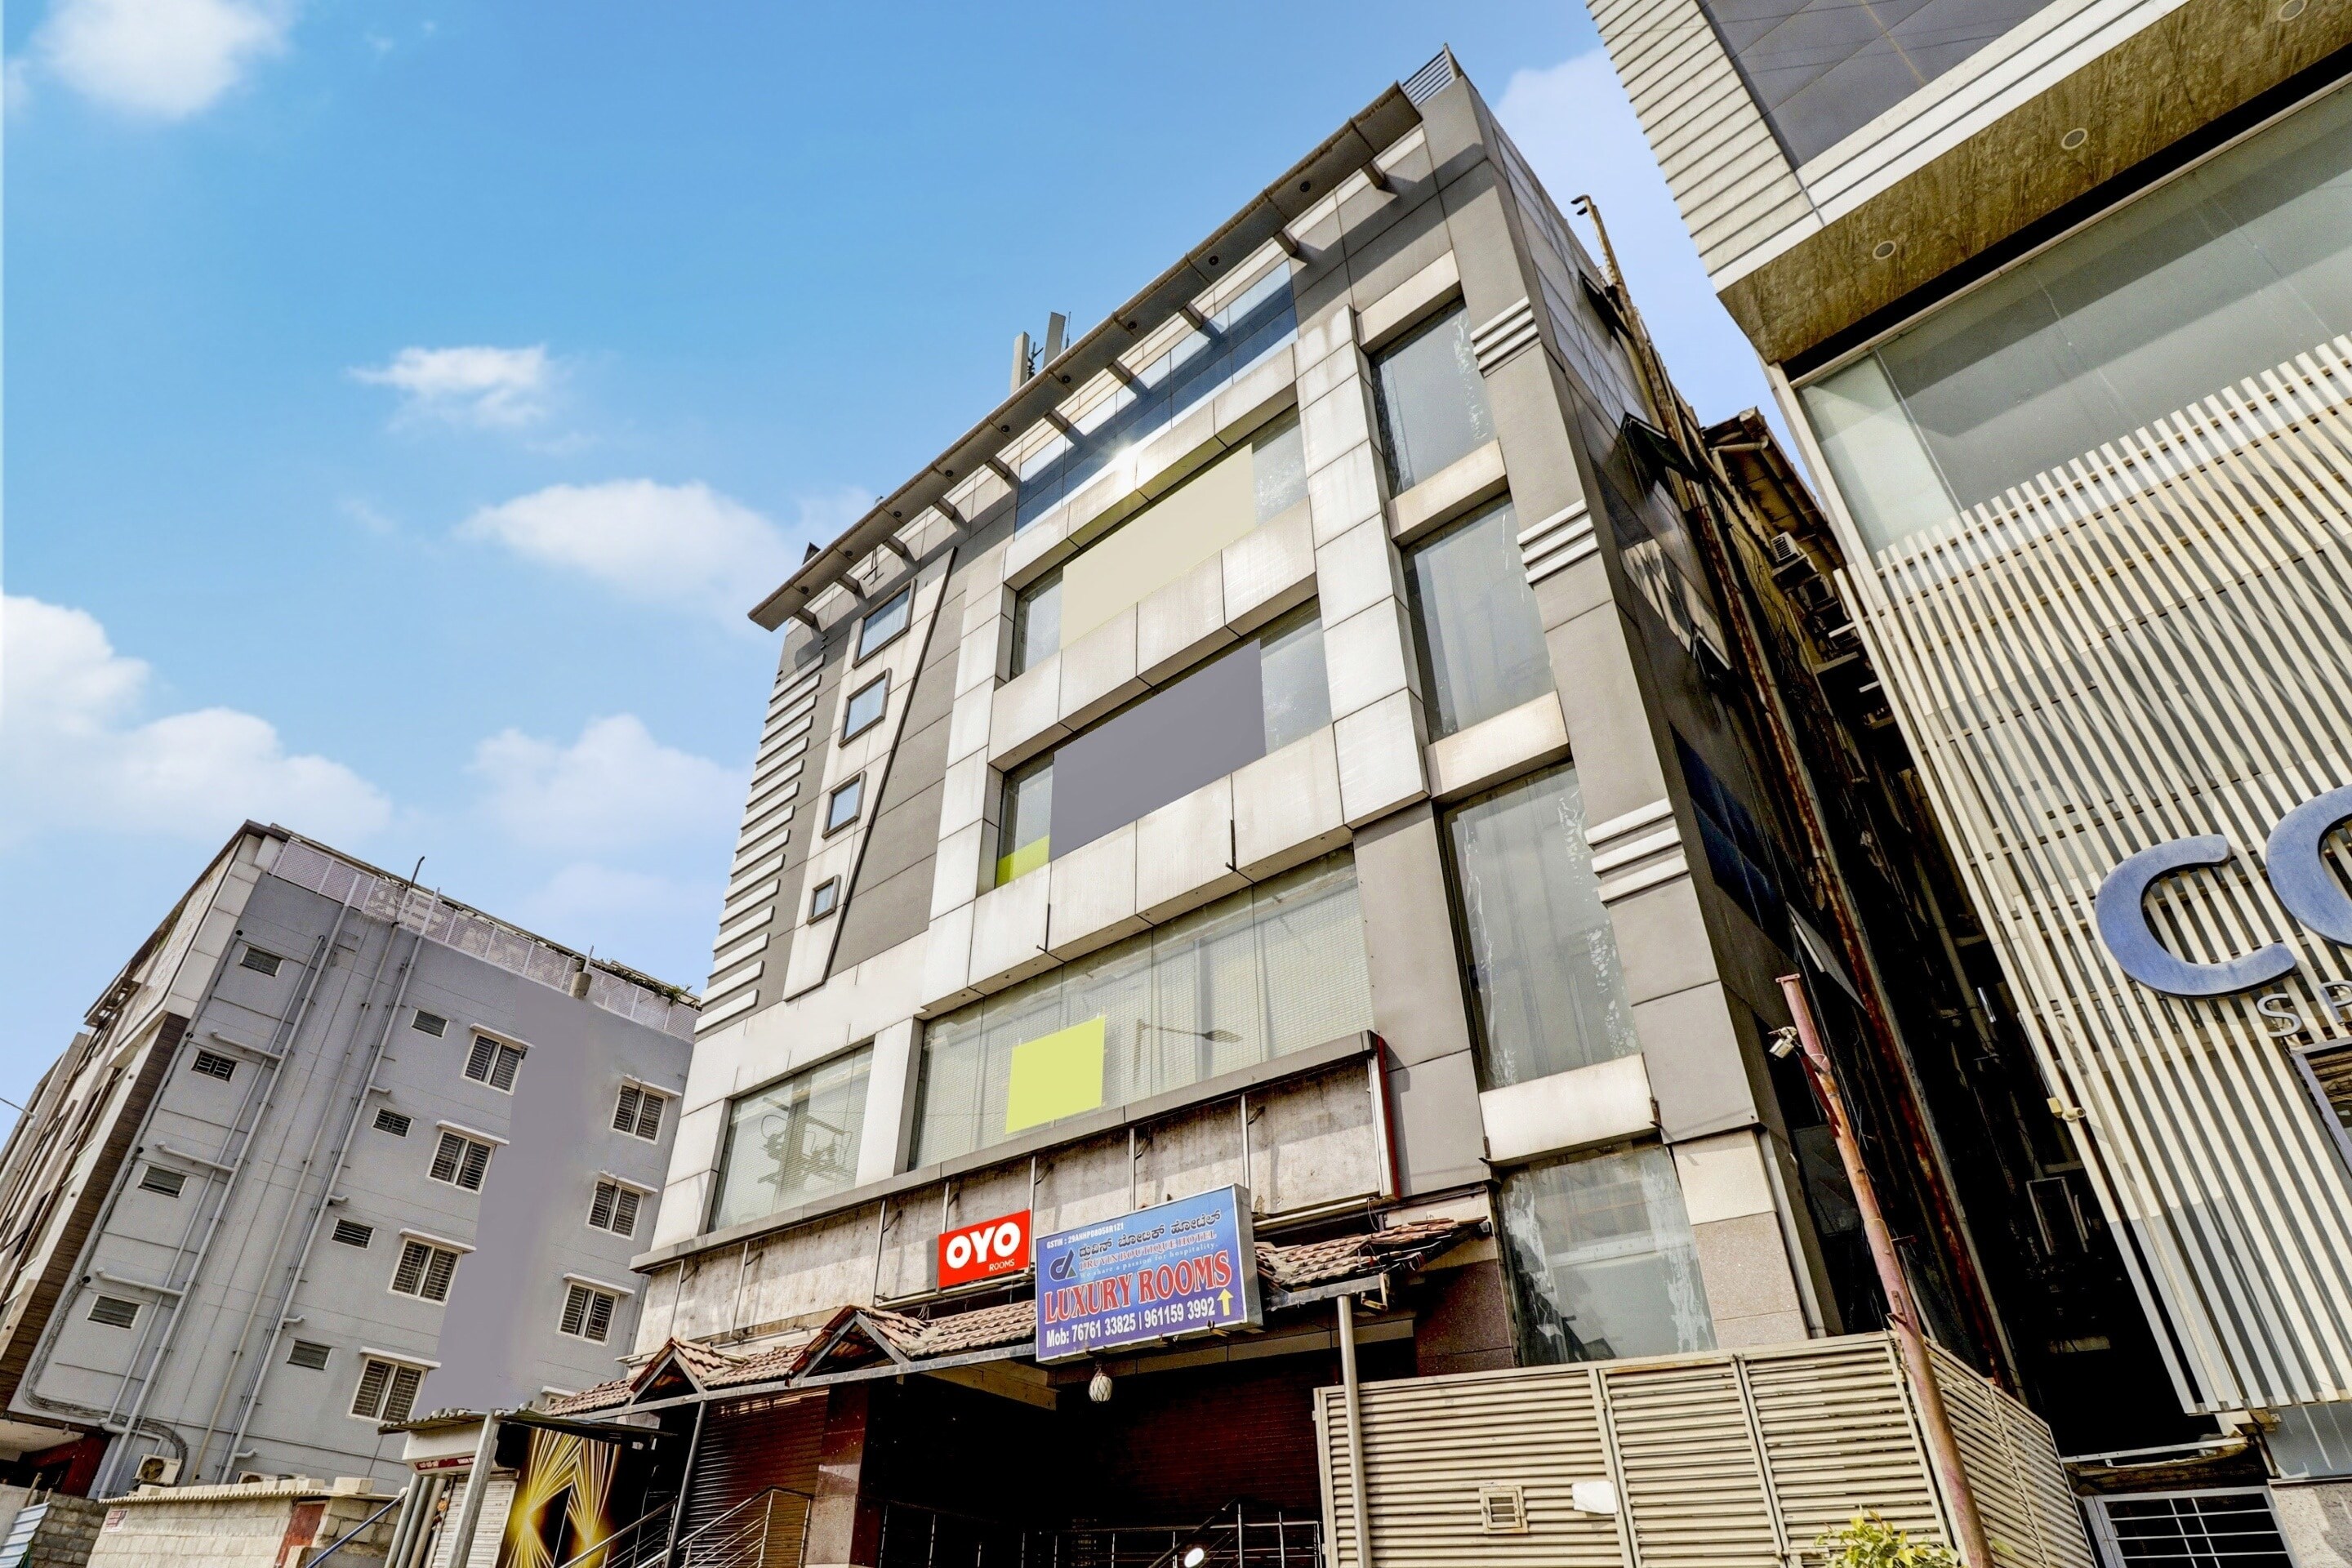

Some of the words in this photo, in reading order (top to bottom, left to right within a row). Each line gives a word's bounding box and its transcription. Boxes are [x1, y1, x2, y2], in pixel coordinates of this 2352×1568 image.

[946, 1222, 1021, 1269] OYO
[989, 1258, 1015, 1272] ROOMS
[1047, 1239, 1063, 1250] GSTIN
[1079, 1254, 1120, 1271] DRUVIN
[1120, 1239, 1177, 1263] BOUTIQUE
[1177, 1230, 1217, 1248] HOTEL
[1080, 1271, 1091, 1279] We
[1094, 1266, 1112, 1276] share
[1123, 1257, 1152, 1271] passion
[1155, 1252, 1167, 1262] for
[1045, 1273, 1133, 1324] LUXURY
[1137, 1250, 1232, 1304] ROOMS
[1046, 1329, 1069, 1348] Mob:
[1071, 1321, 1102, 1341] 76761
[1104, 1312, 1136, 1336] 33825
[1144, 1303, 1183, 1329] 961159
[1187, 1297, 1215, 1319] 3992
